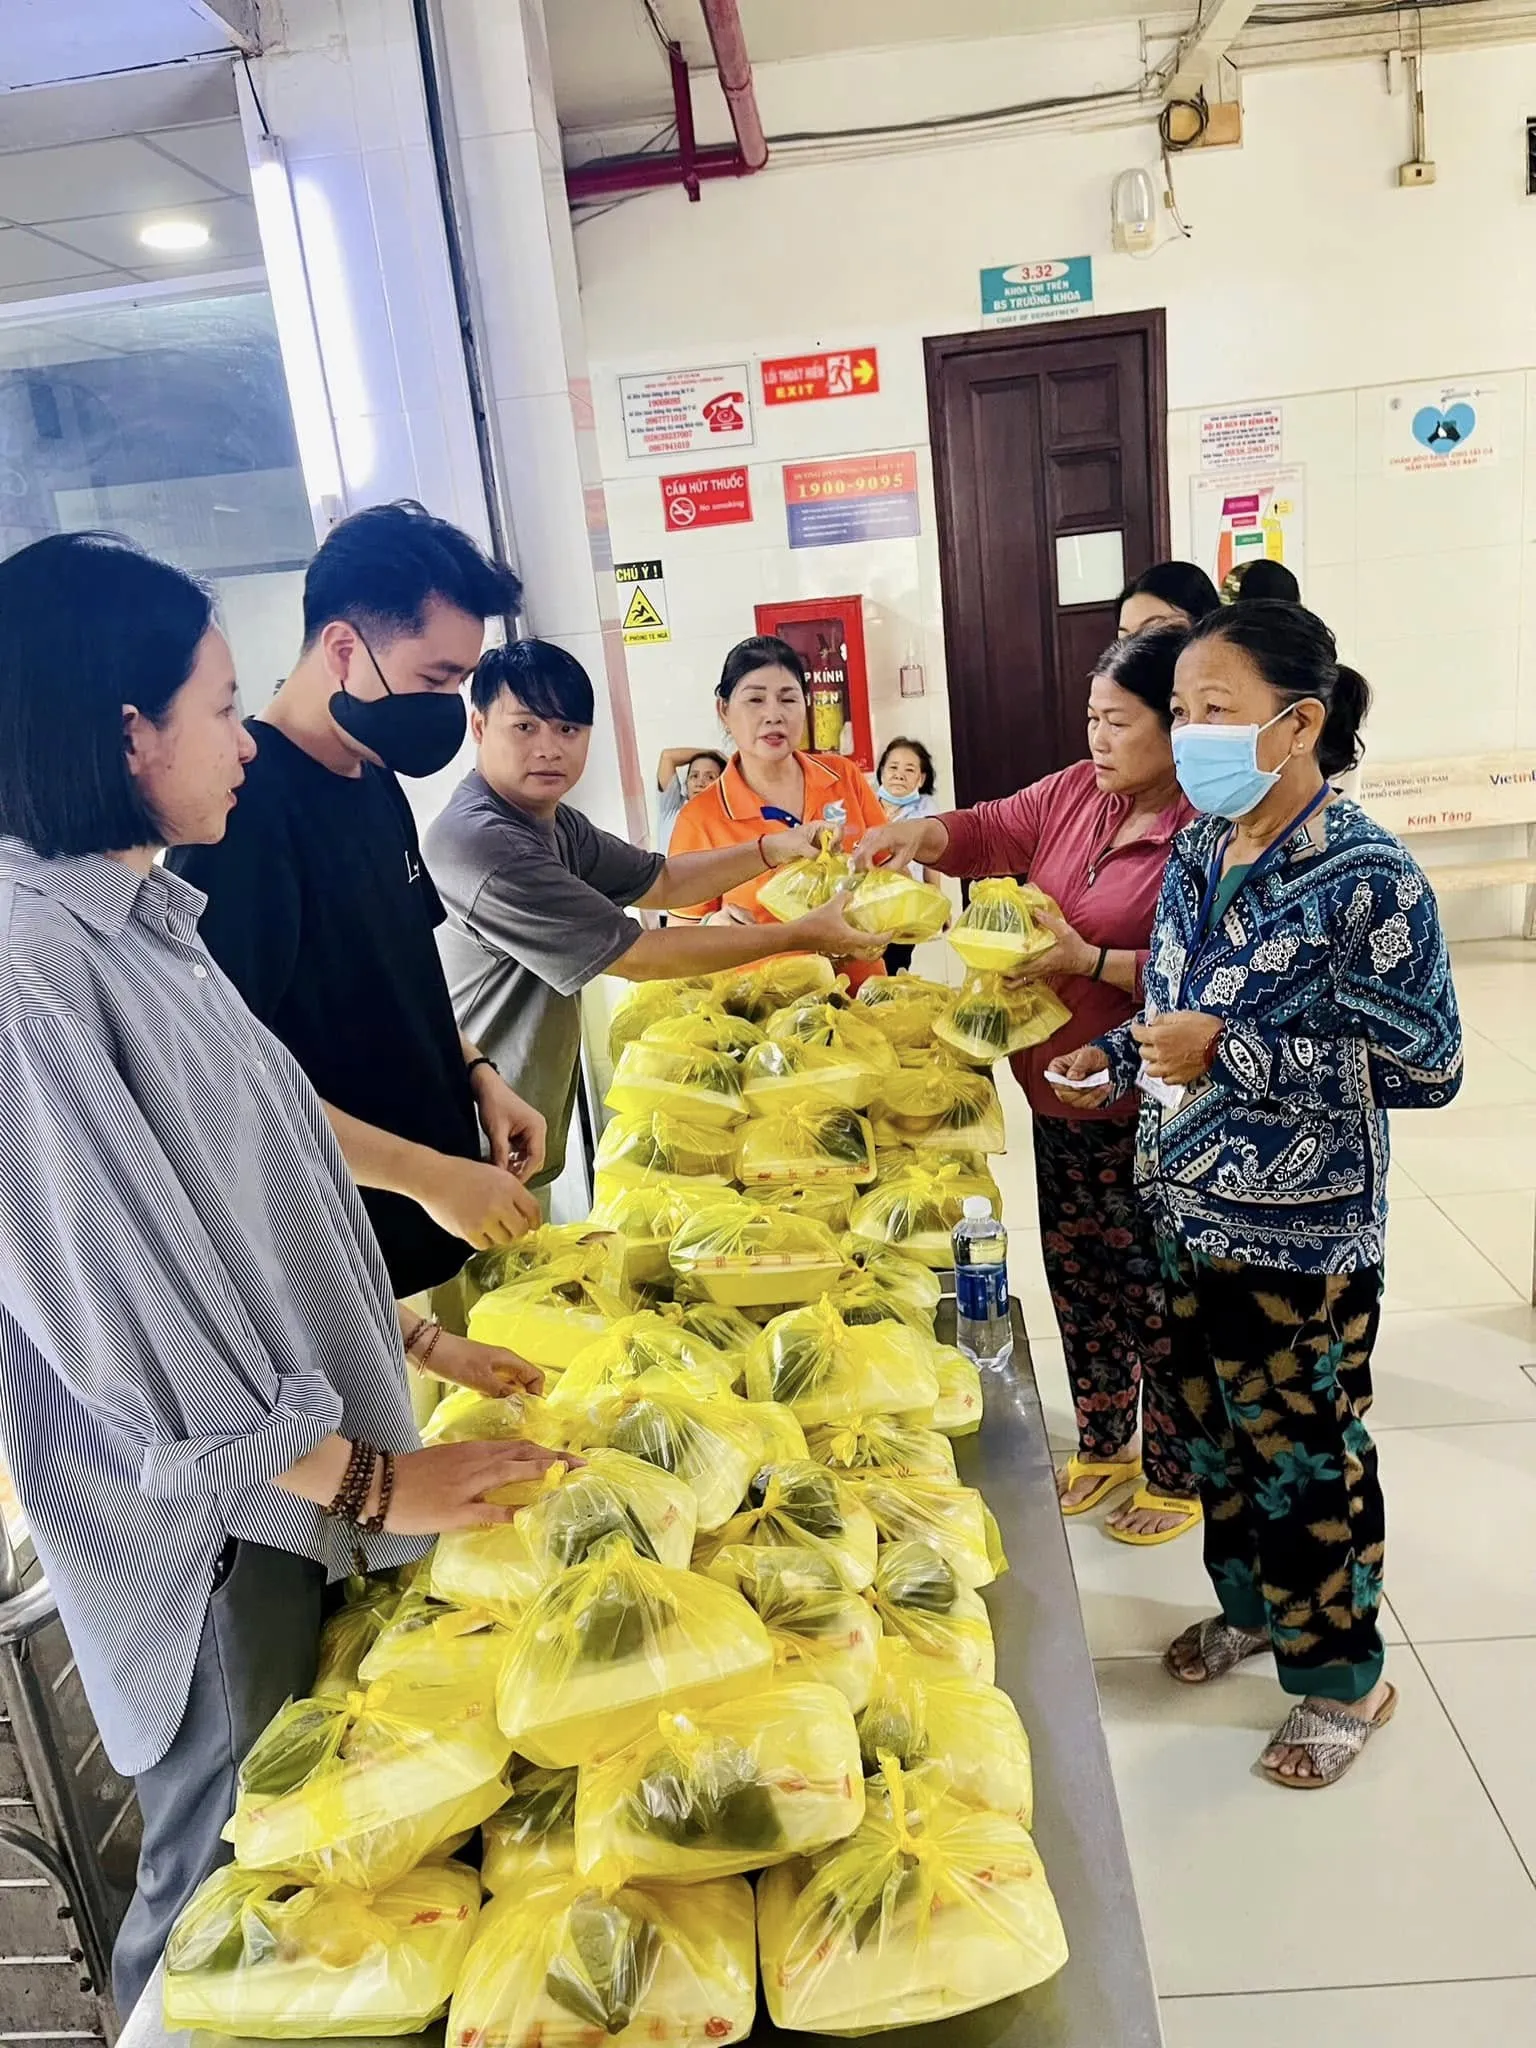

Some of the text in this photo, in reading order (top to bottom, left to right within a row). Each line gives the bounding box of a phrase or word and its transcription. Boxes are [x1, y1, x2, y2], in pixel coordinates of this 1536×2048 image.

[1022, 263, 1052, 281] 3.32
[993, 299, 1008, 311] BS
[1053, 290, 1081, 303] KHOA
[1004, 286, 1027, 297] KHOA
[776, 383, 815, 399] EXIT
[665, 472, 745, 497] CẤM HÚT THUỐC
[797, 472, 904, 499] 1900-9095
[616, 564, 639, 582] CHÚ
[641, 563, 649, 579] Ý
[813, 667, 844, 683] KÍNH
